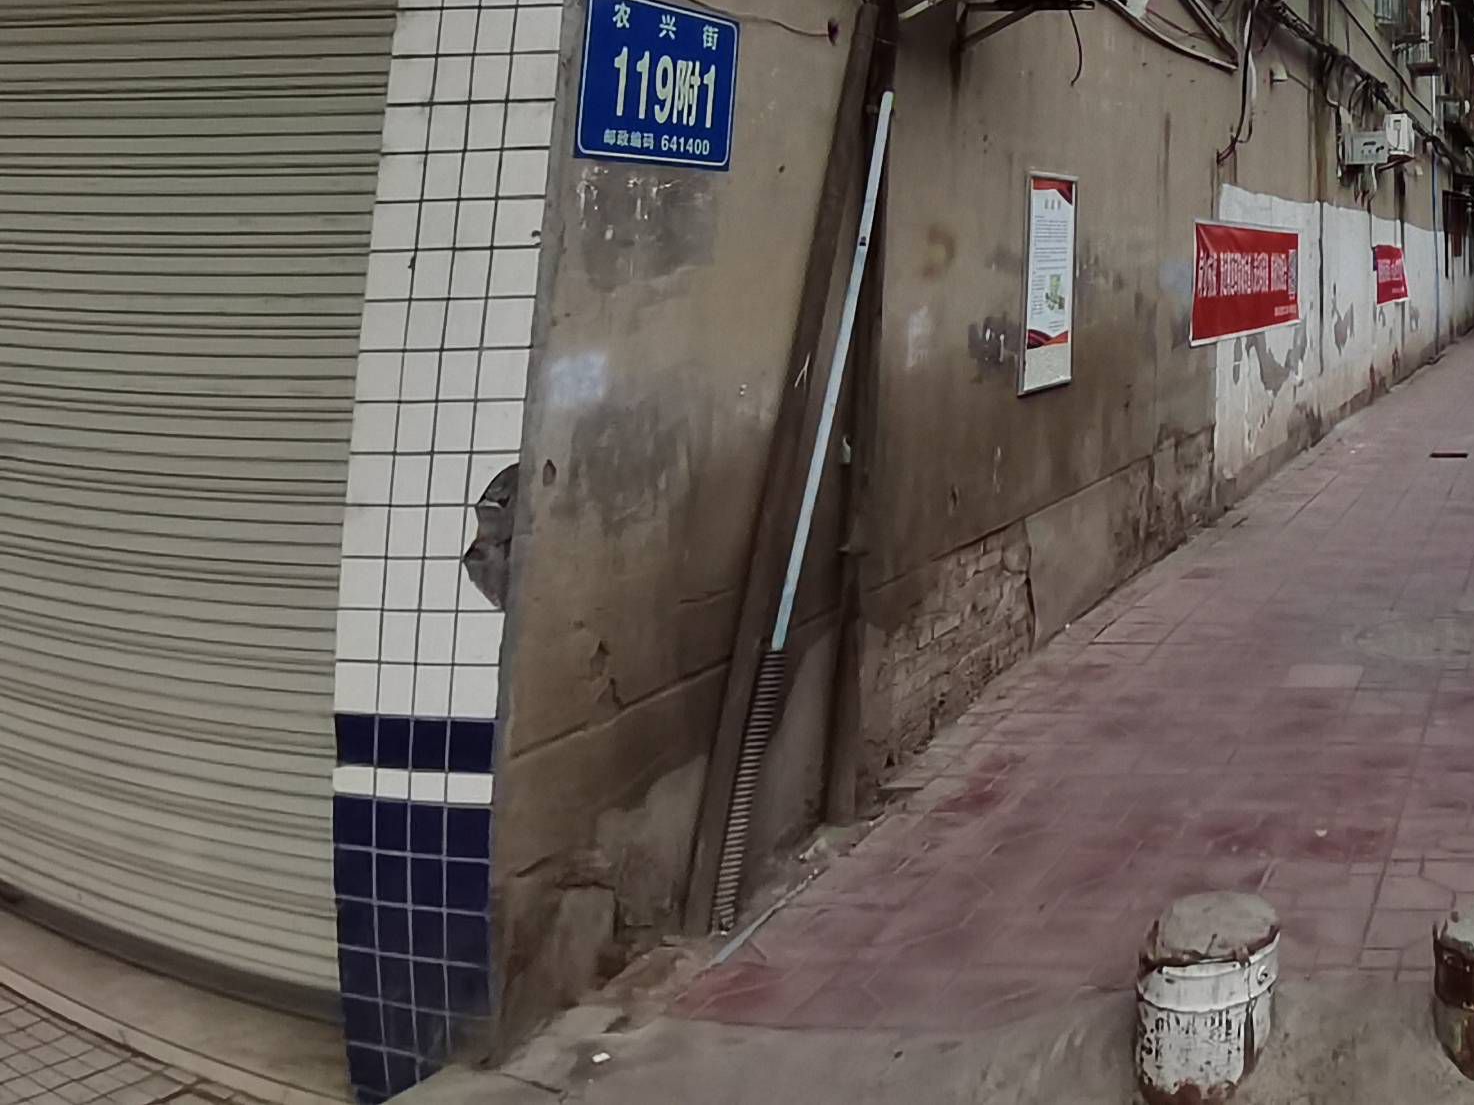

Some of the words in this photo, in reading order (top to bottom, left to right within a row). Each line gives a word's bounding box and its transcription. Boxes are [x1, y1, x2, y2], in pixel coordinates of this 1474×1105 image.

[612, 2, 720, 51] 农兴街
[613, 45, 717, 129] 119附1
[603, 128, 655, 151] 邮政编码
[660, 134, 710, 156] 641400
